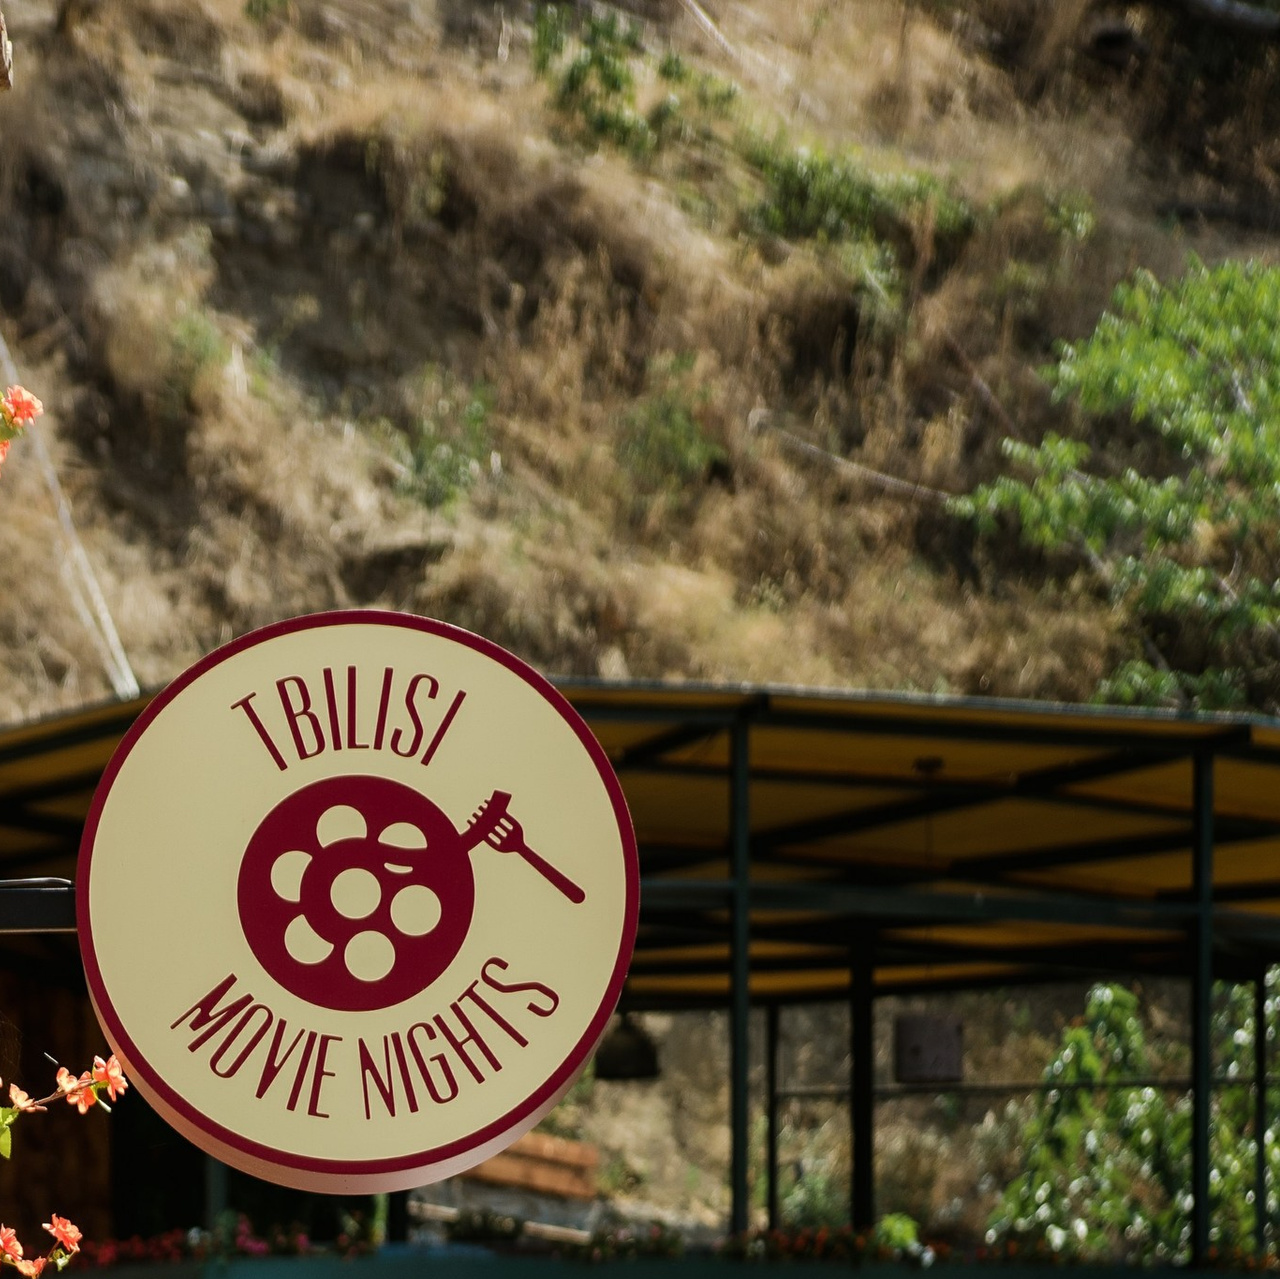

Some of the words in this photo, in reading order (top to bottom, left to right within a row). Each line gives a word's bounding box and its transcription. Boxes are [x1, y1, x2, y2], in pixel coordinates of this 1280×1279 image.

[230, 665, 467, 772] TBILISI
[170, 973, 343, 1119] MOVIE
[358, 957, 560, 1120] NIGHTS
